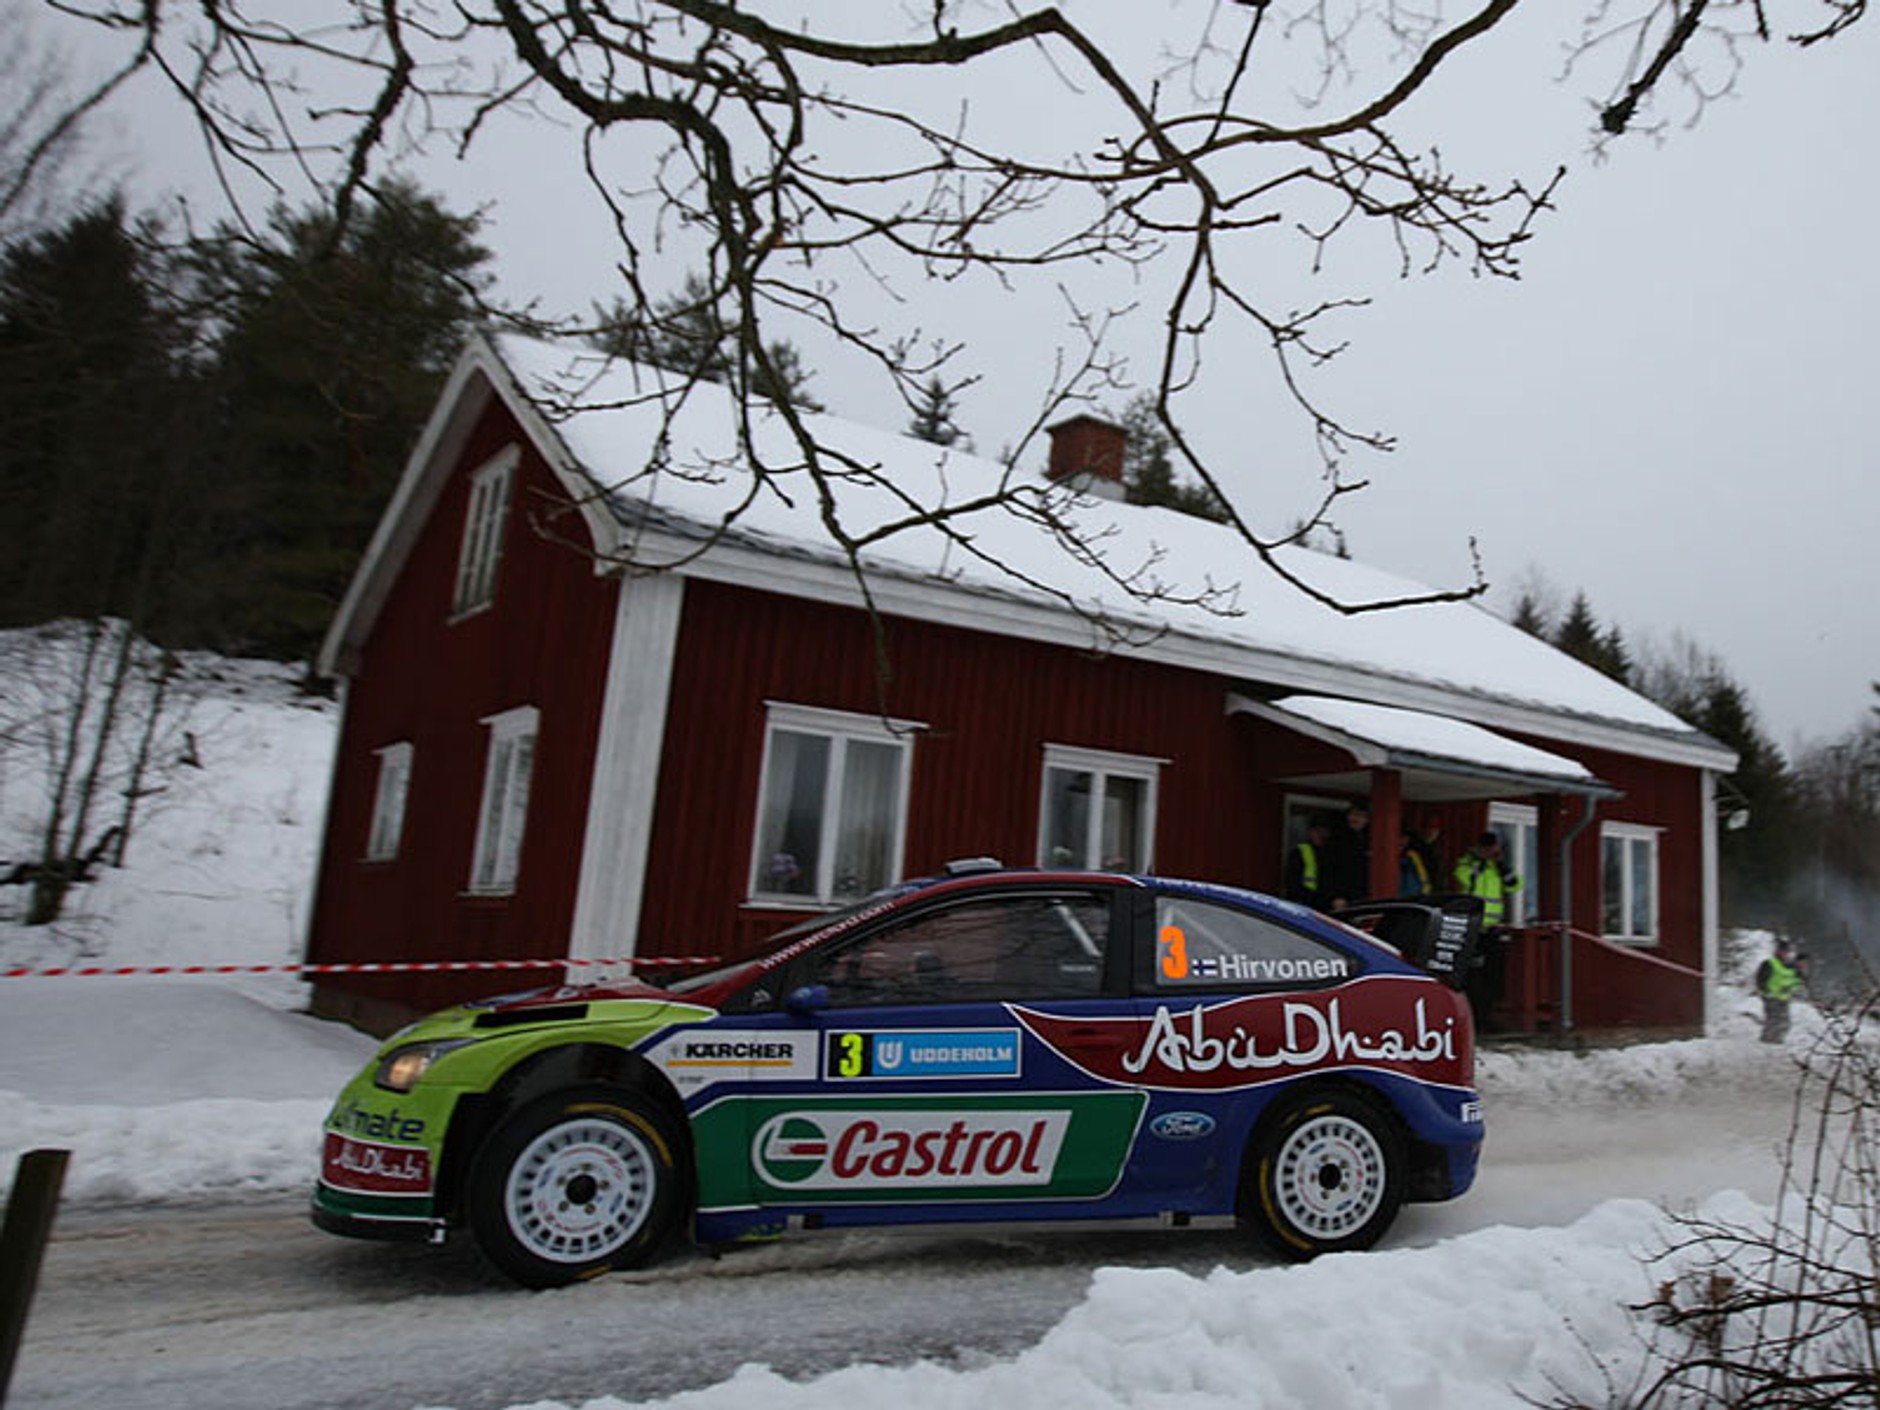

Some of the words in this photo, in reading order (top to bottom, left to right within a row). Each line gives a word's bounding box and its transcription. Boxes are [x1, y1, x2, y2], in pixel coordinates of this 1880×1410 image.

[1159, 925, 1188, 979] 3
[1219, 953, 1347, 979] Hirvonen
[839, 1033, 863, 1077] 3
[910, 1047, 1012, 1063] UDDEHOLM
[831, 1119, 1047, 1179] Castrol
